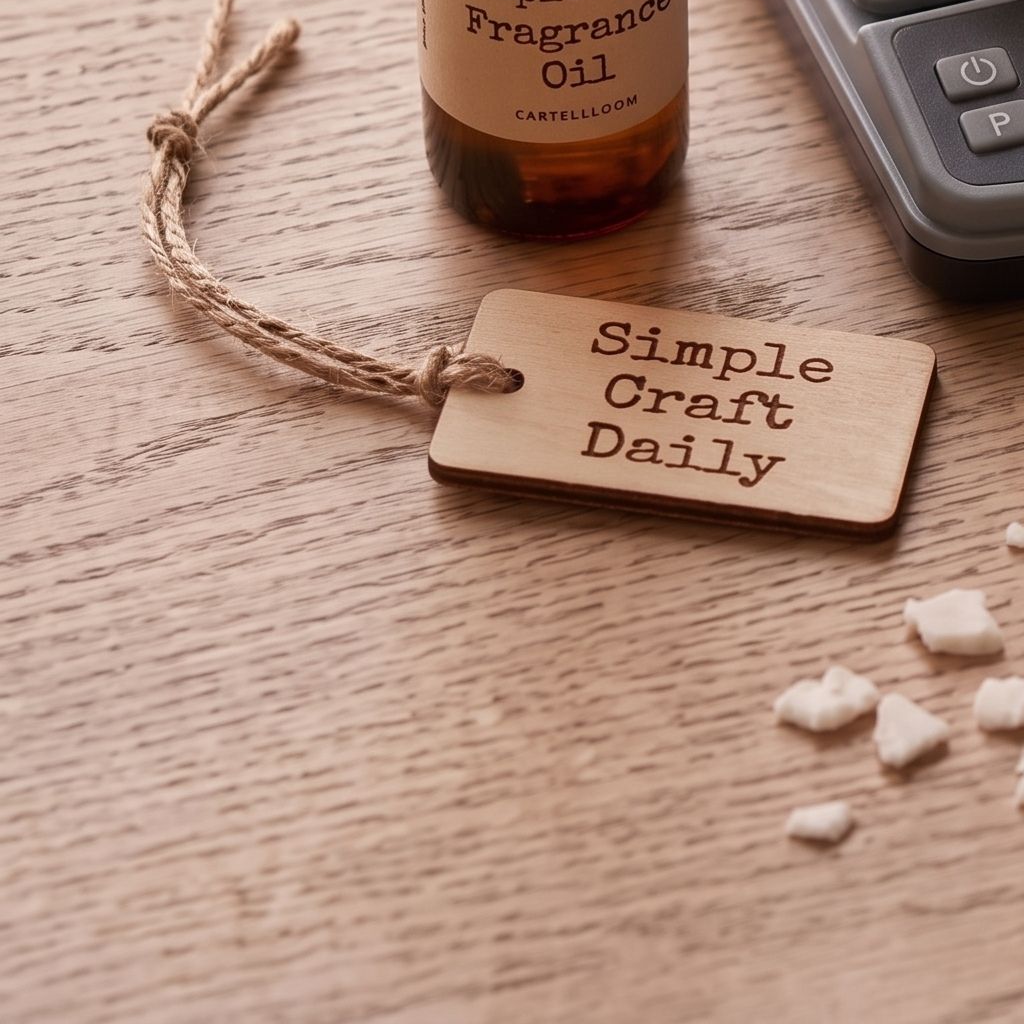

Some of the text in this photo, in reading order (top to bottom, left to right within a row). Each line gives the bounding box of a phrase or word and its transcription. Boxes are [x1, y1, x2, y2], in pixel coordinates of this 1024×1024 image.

[541, 53, 617, 90] Oil
[515, 94, 639, 122] CARTELLLOOM
[990, 111, 1011, 138] P
[591, 321, 834, 383] Simple
[604, 373, 795, 430] Craft
[581, 421, 786, 488] Daily
